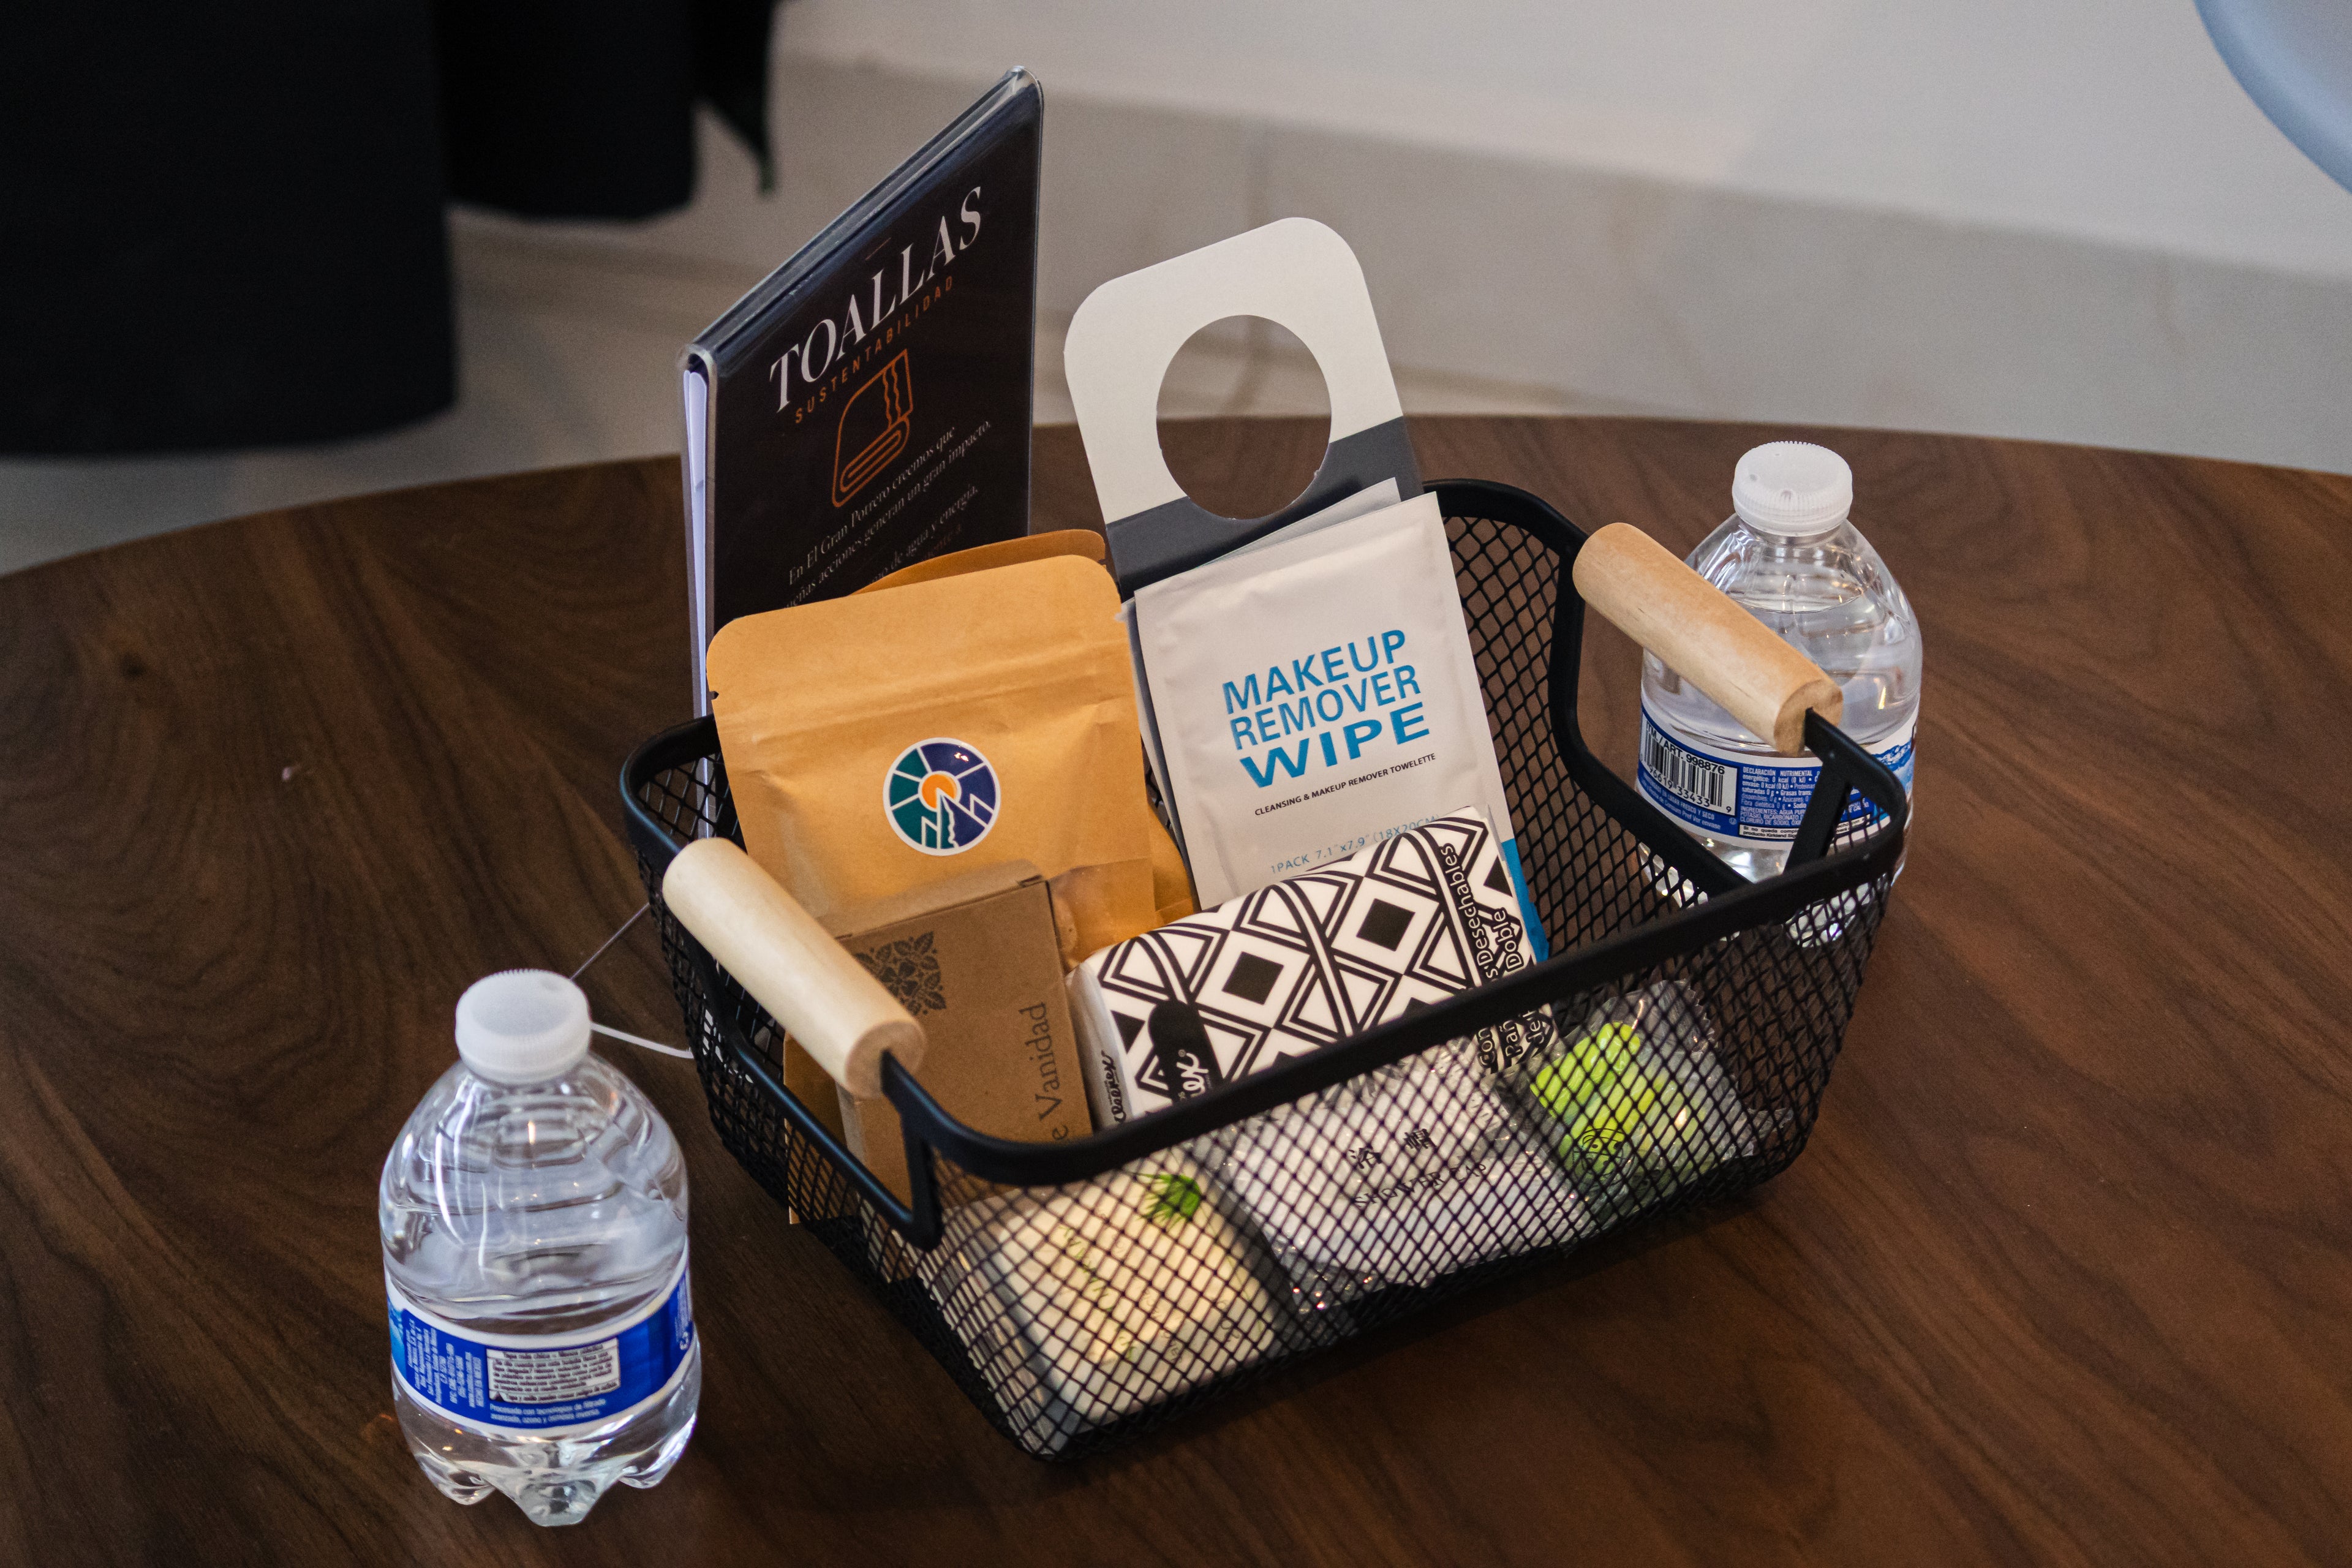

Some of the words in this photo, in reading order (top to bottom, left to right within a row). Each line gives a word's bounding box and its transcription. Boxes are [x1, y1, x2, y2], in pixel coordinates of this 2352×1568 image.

[771, 186, 981, 414] TOALLAS
[795, 276, 954, 424] SUSTENTABILIDAD
[786, 581, 816, 608] ueñas
[818, 538, 862, 583] acciones
[864, 498, 905, 546] generan
[907, 483, 921, 501] un
[922, 460, 946, 492] gran
[789, 565, 804, 586] En
[807, 545, 818, 568] El
[821, 525, 848, 555] Gran
[851, 486, 890, 527] Potrero
[892, 448, 934, 490] creemos
[936, 426, 955, 451] que
[891, 549, 903, 570] de
[906, 529, 929, 557] agua
[1222, 629, 1406, 715] MAKEUP
[1229, 665, 1421, 750] REMOVER
[1239, 701, 1431, 788] WIPE
[1254, 795, 1302, 816] CLEANSING
[1311, 780, 1347, 799] MAKEUP
[1348, 767, 1389, 786] REMOVER
[1390, 753, 1436, 775] TOWELETTE
[1664, 740, 1684, 760] ART.
[1686, 753, 1725, 775] 998876
[1743, 767, 1776, 776] DECLARACIÓN
[1677, 786, 1710, 807] 33433
[1702, 810, 1715, 820] SECO
[1702, 820, 1721, 830] envase
[1440, 842, 1494, 967] Desechables
[1493, 907, 1524, 970] Doble
[1018, 1001, 1065, 1120] Vanidad
